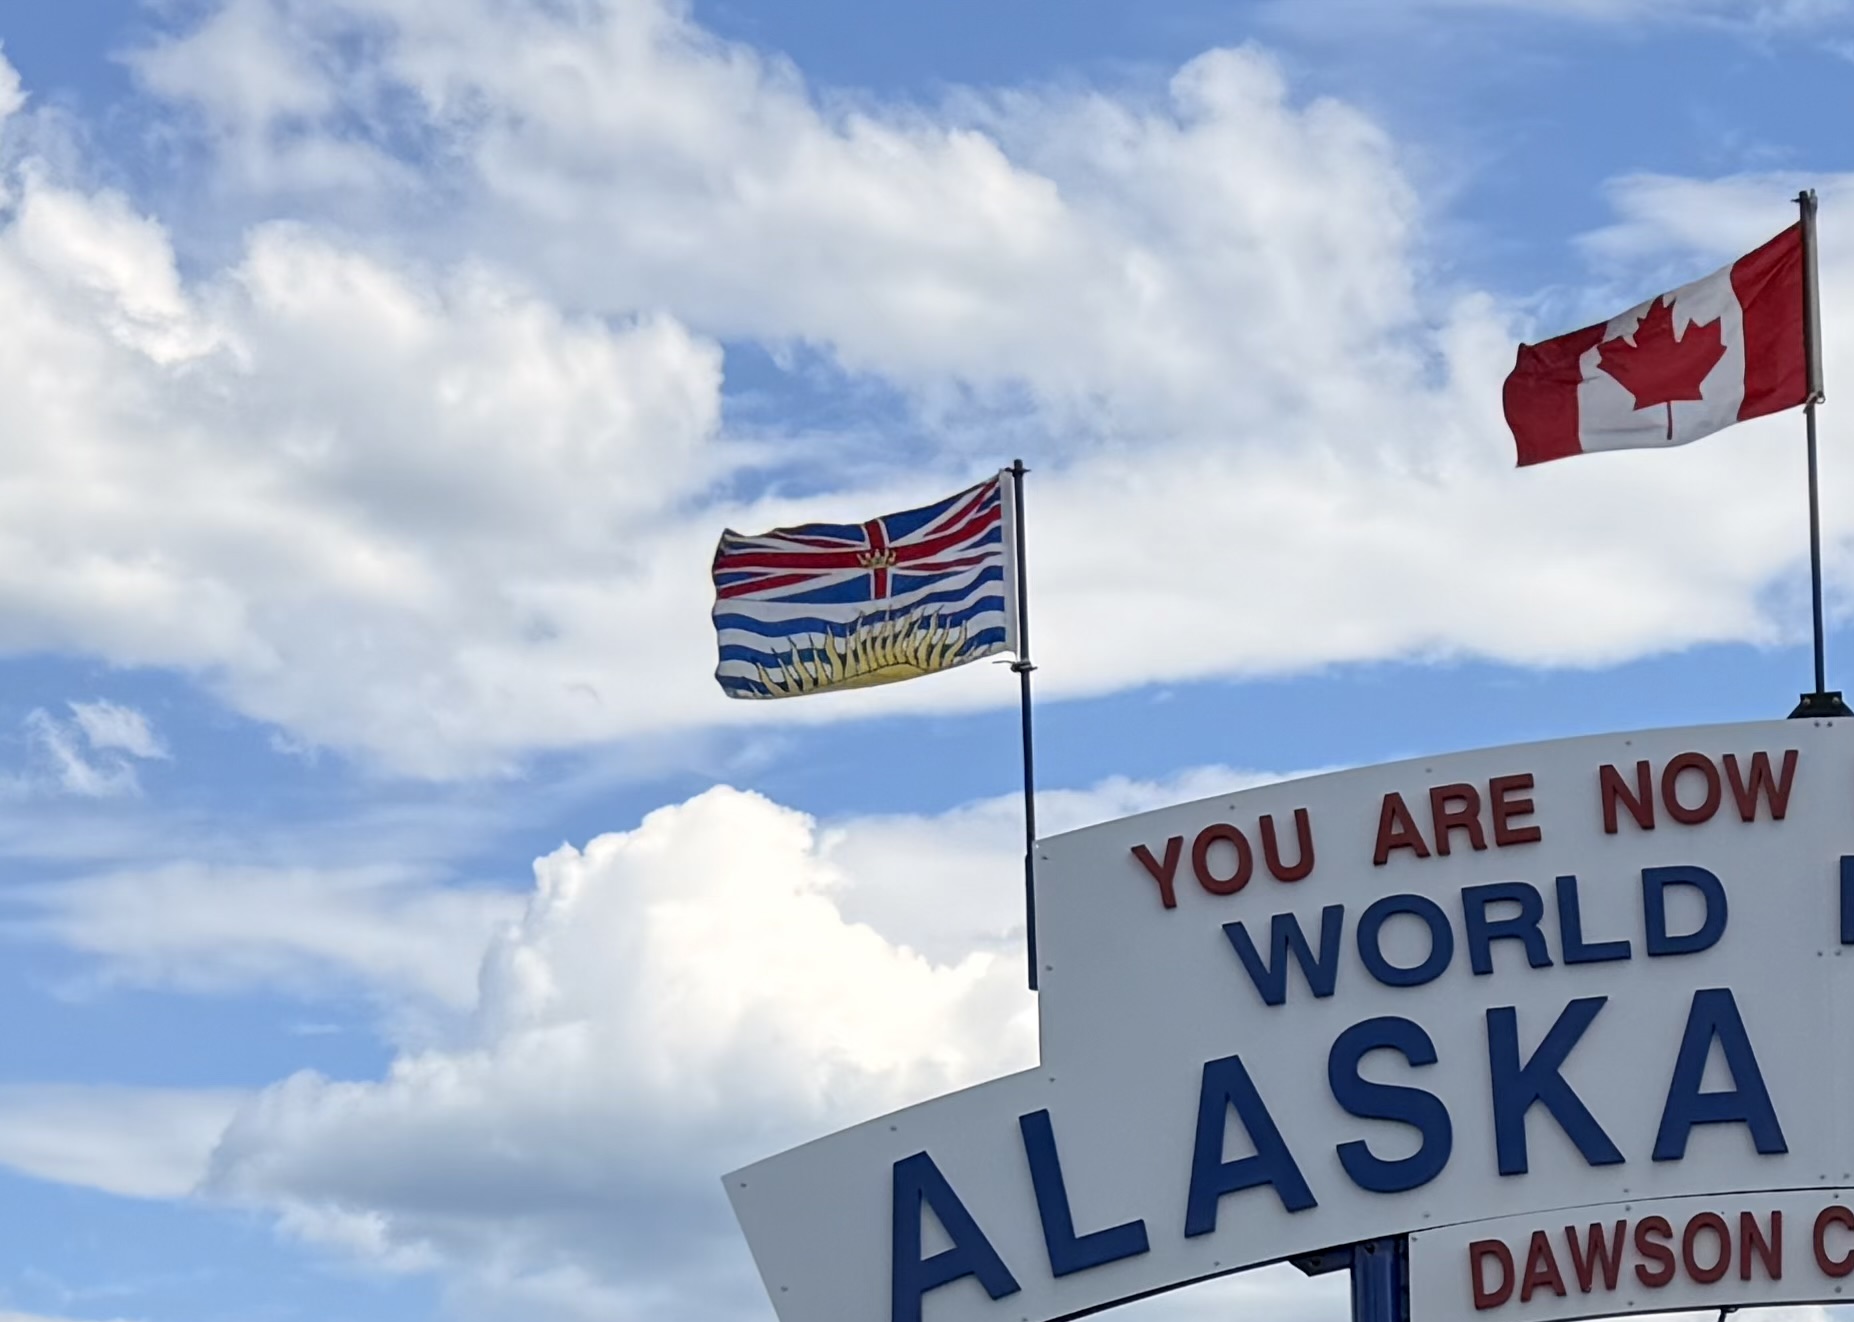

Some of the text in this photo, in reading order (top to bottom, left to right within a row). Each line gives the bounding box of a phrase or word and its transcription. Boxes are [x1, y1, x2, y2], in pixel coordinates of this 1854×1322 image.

[1135, 810, 1314, 908] YOU
[1374, 774, 1541, 865] ARE
[1601, 750, 1798, 834] NOW
[1221, 865, 1729, 1006] WORLD
[1469, 1211, 1783, 1310] DAWSON
